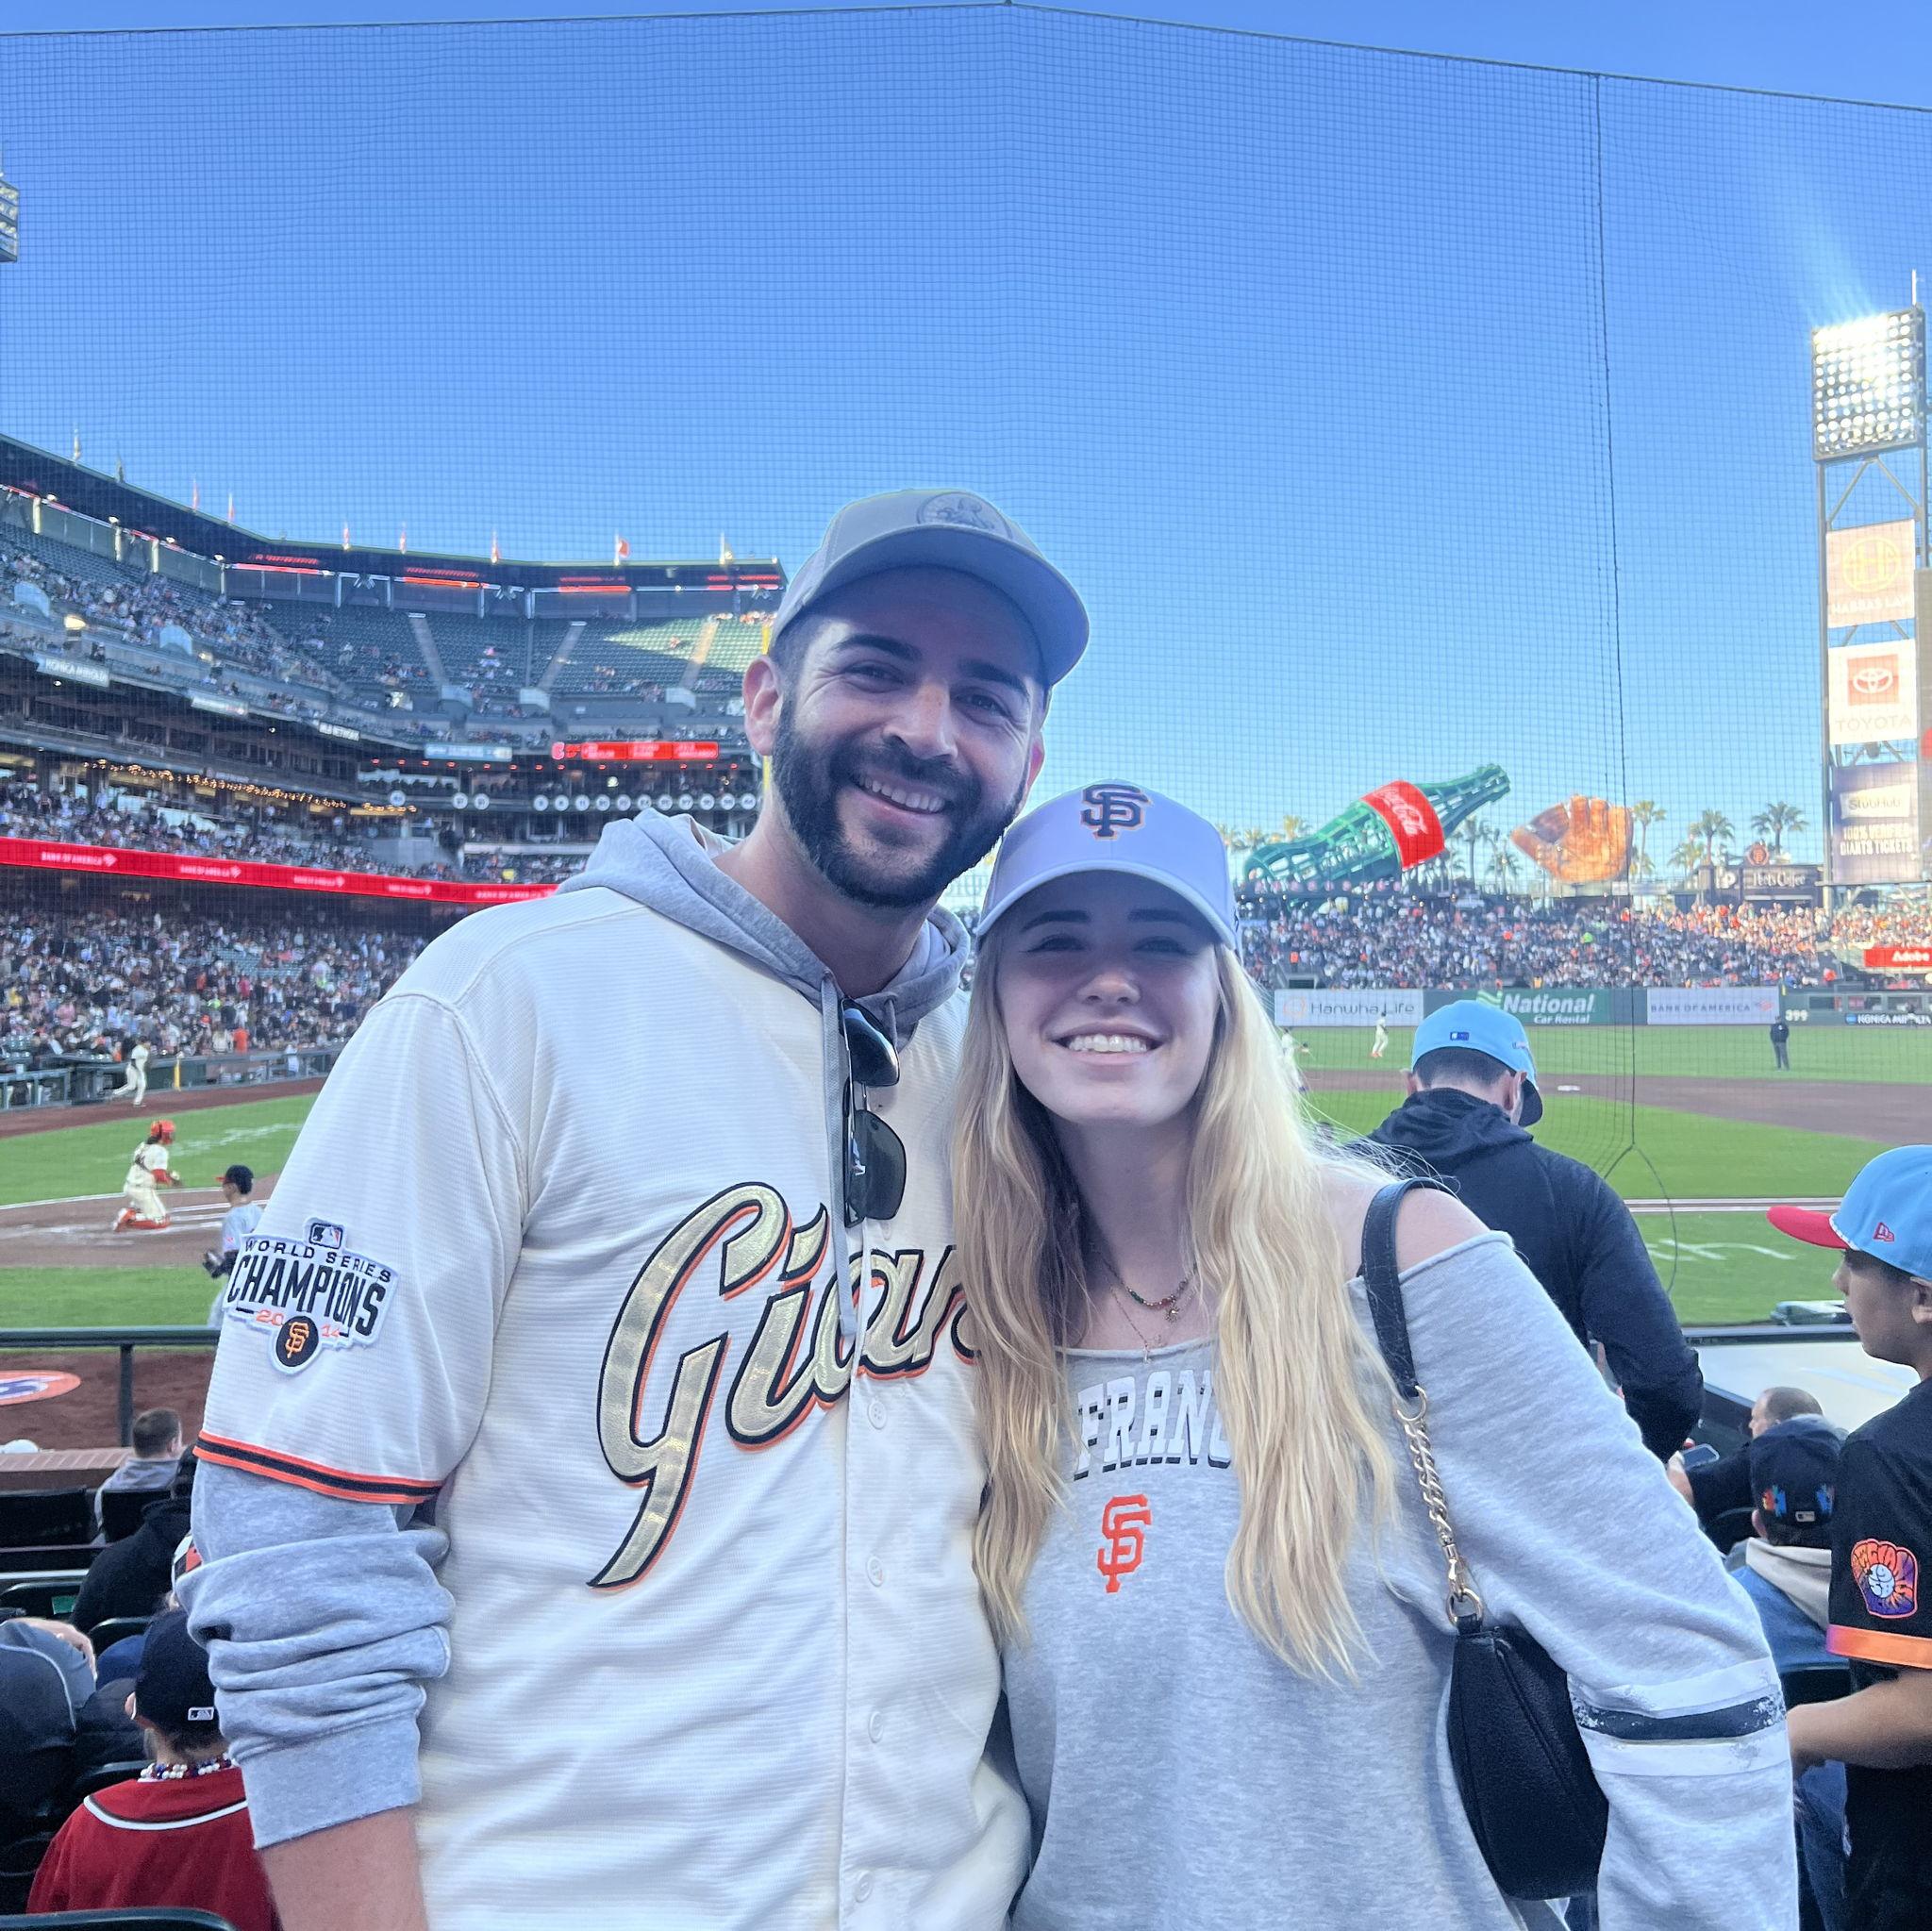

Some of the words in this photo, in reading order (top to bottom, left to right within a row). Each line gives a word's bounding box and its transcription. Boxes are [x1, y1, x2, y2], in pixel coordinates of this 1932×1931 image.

[1835, 714, 1912, 733] TOYOTA
[1849, 796, 1901, 810] StubHub
[1891, 950, 1930, 962] Adobe
[1310, 1003, 1379, 1015] Hanwha
[1384, 1003, 1415, 1015] Life
[1503, 993, 1595, 1013] National
[1650, 1004, 1680, 1012] BANK
[1684, 1004, 1698, 1012] OF
[1700, 1004, 1751, 1012] AMERICA
[1533, 1014, 1554, 1024] Car
[1555, 1013, 1591, 1024] Rental
[1857, 1013, 1891, 1024] KONICA
[1891, 1013, 1932, 1024] MILTA
[244, 1238, 315, 1259] WORLD
[325, 1252, 391, 1283] SERIES
[227, 1255, 387, 1337] CHAMPIONS
[256, 1309, 284, 1326] 20
[1096, 1493, 1152, 1594] SF
